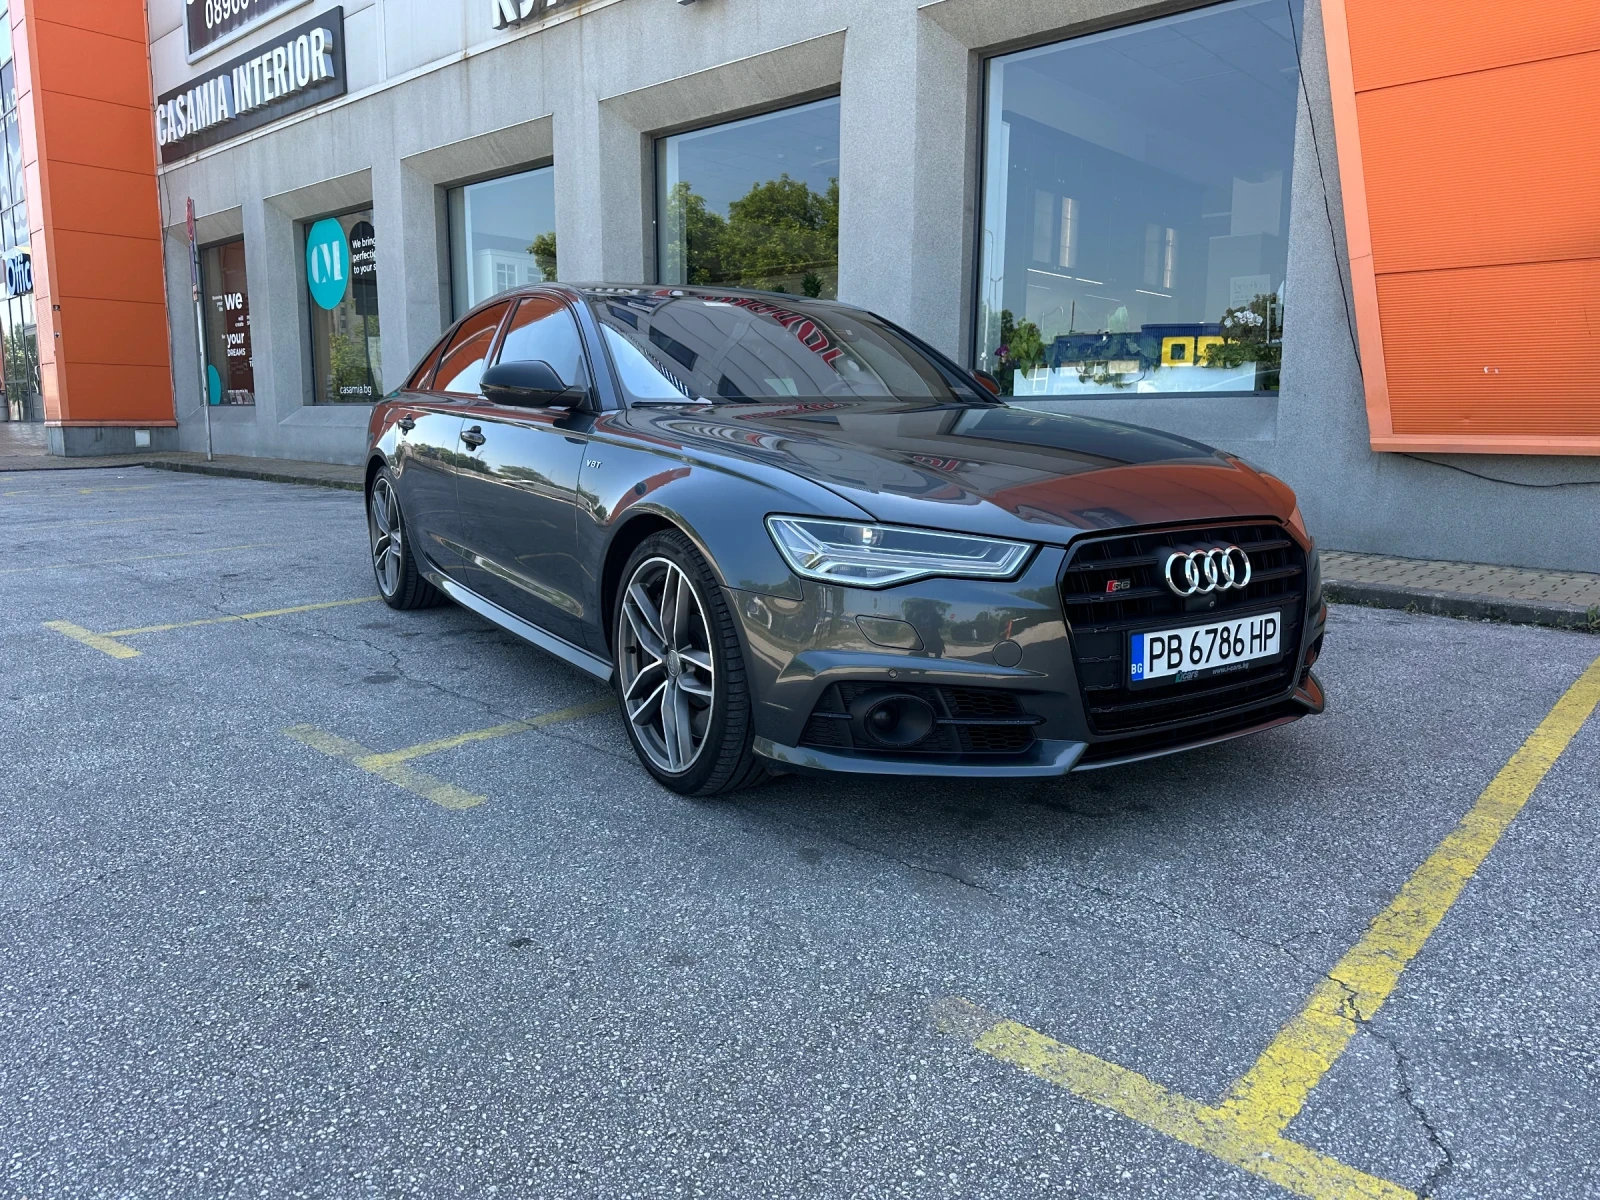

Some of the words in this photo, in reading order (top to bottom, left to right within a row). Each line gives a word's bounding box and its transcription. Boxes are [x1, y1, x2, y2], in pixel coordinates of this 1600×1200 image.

[156, 74, 233, 146] CASAMIA
[232, 27, 333, 115] INTERIOR
[352, 238, 361, 249] We
[353, 265, 360, 274] to
[360, 264, 372, 275] your
[224, 292, 243, 311] we
[226, 333, 245, 348] your
[227, 347, 246, 357] DREAMS
[340, 383, 372, 396] casamia.bg
[586, 459, 602, 469] V8T
[1148, 633, 1183, 673] PB
[1189, 623, 1245, 665] 6786
[1249, 617, 1277, 654] HP
[1131, 663, 1143, 675] BG
[1212, 662, 1250, 675] www.i-cars.bg
